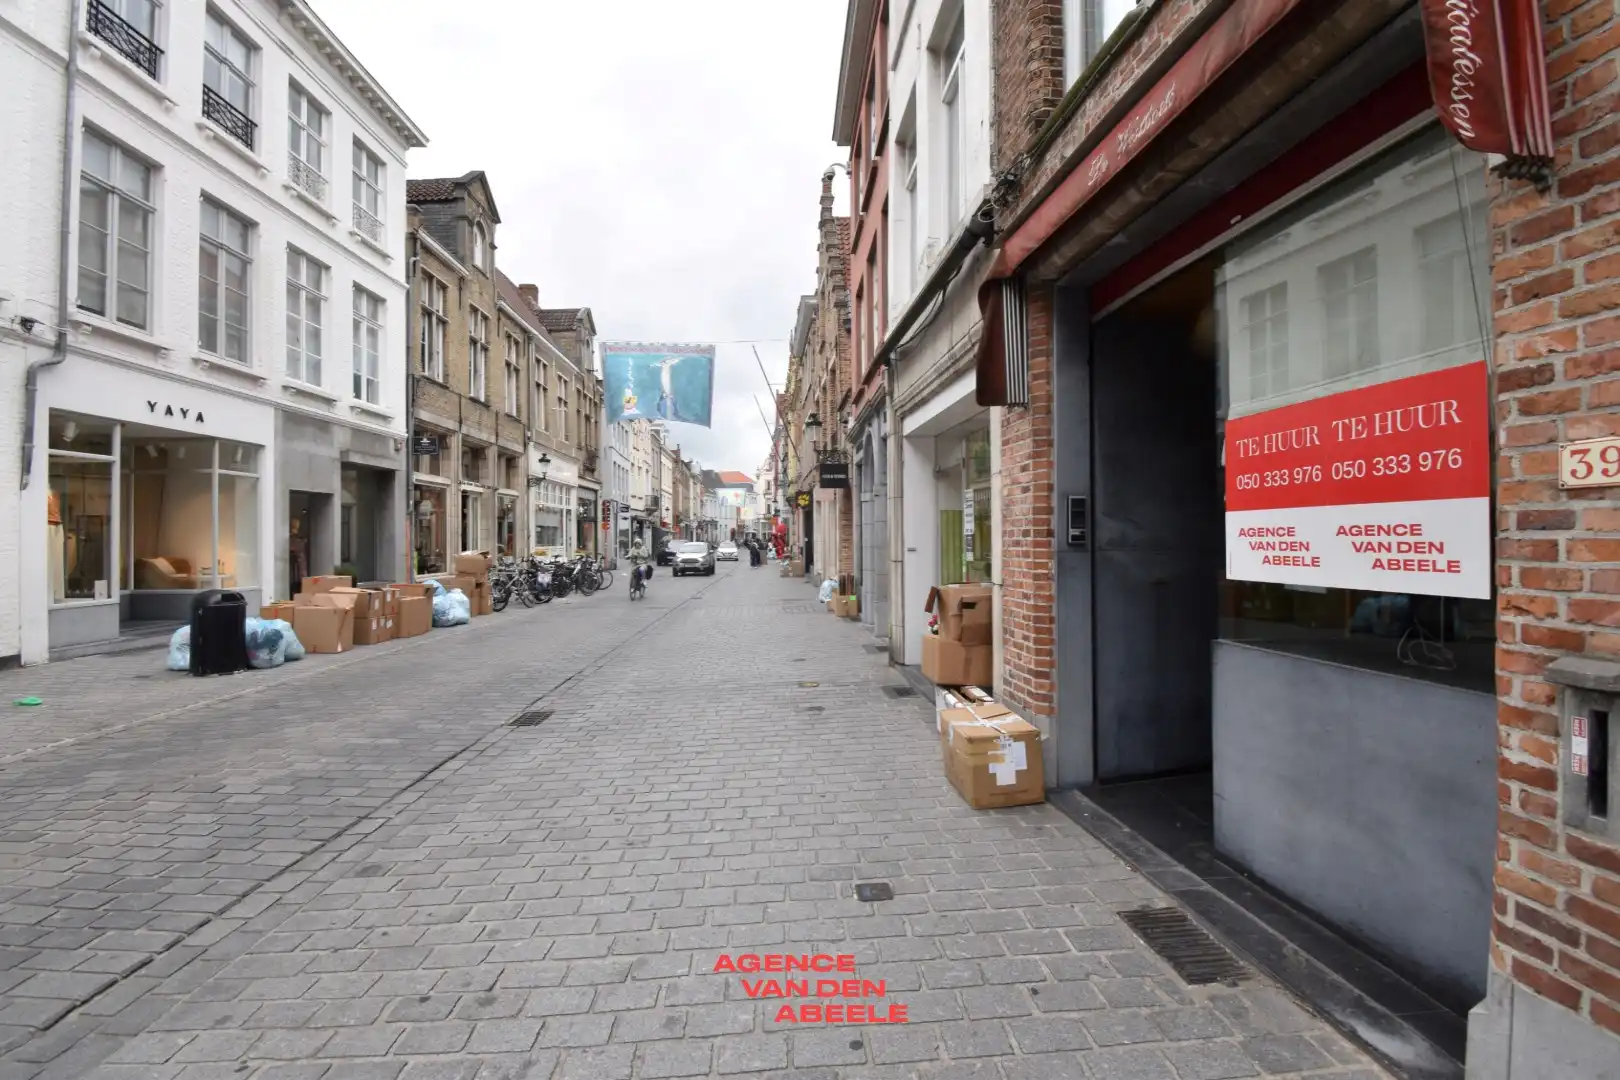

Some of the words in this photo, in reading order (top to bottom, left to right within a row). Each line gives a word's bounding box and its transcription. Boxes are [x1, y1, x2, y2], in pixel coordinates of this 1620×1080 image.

[147, 400, 204, 422] YAYA
[1332, 416, 1367, 441] TE
[1374, 400, 1462, 435] HUUR
[1236, 437, 1259, 457] TE
[1264, 426, 1320, 453] HUUR
[1332, 460, 1365, 479] 050
[1373, 455, 1411, 475] 333
[1419, 448, 1462, 471] 976
[1570, 446, 1620, 479] 39
[1237, 474, 1259, 489] 050
[1264, 470, 1288, 486] 333
[1294, 465, 1321, 483] 976
[1238, 527, 1295, 538] AGENCE
[1336, 524, 1422, 536] AGENCE
[1249, 541, 1275, 551] VAN
[1278, 541, 1310, 551] DEN
[1352, 541, 1392, 553] VAN
[1397, 541, 1444, 554] DEN
[1262, 555, 1320, 567] ABEELE
[1372, 558, 1461, 573] ABEELE
